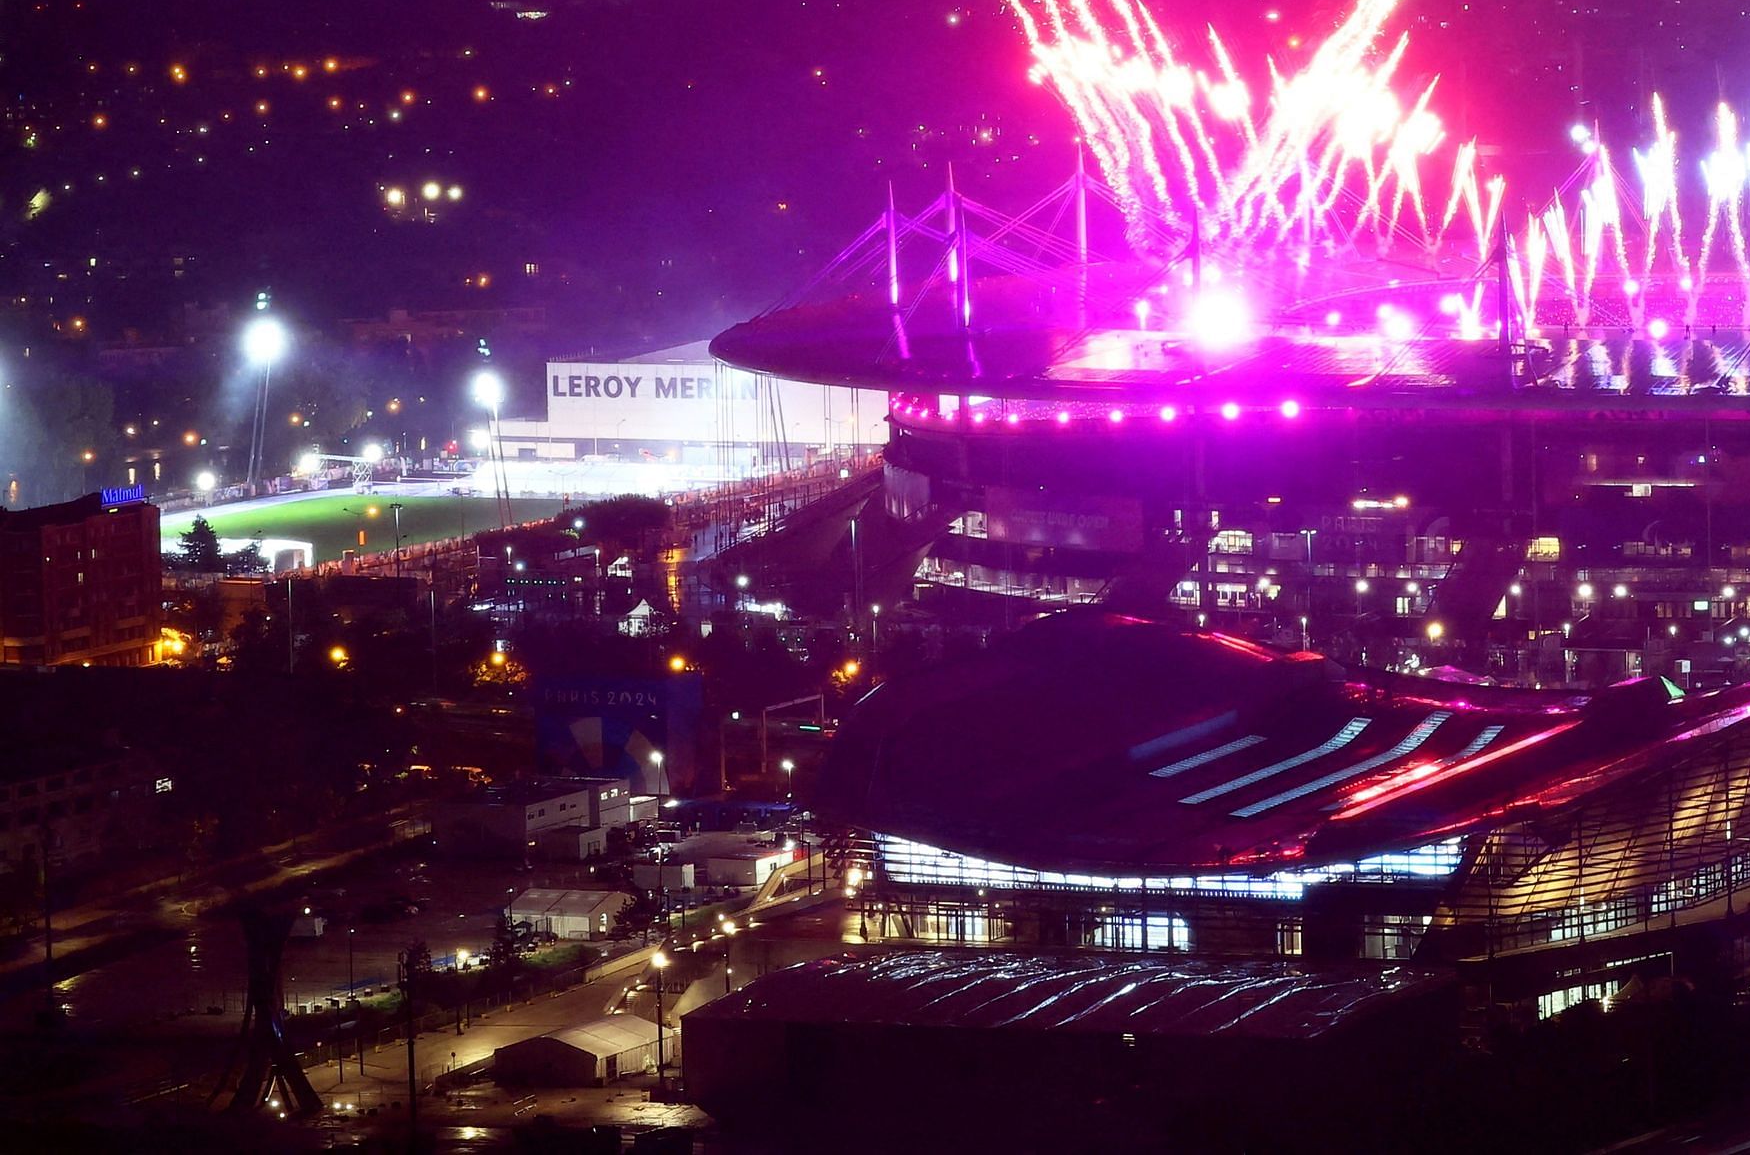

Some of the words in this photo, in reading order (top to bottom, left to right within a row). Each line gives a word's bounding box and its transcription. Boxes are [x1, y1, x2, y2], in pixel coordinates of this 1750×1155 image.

[552, 375, 642, 398] LEROY
[544, 688, 600, 705] PARIS
[607, 690, 657, 706] 2024
